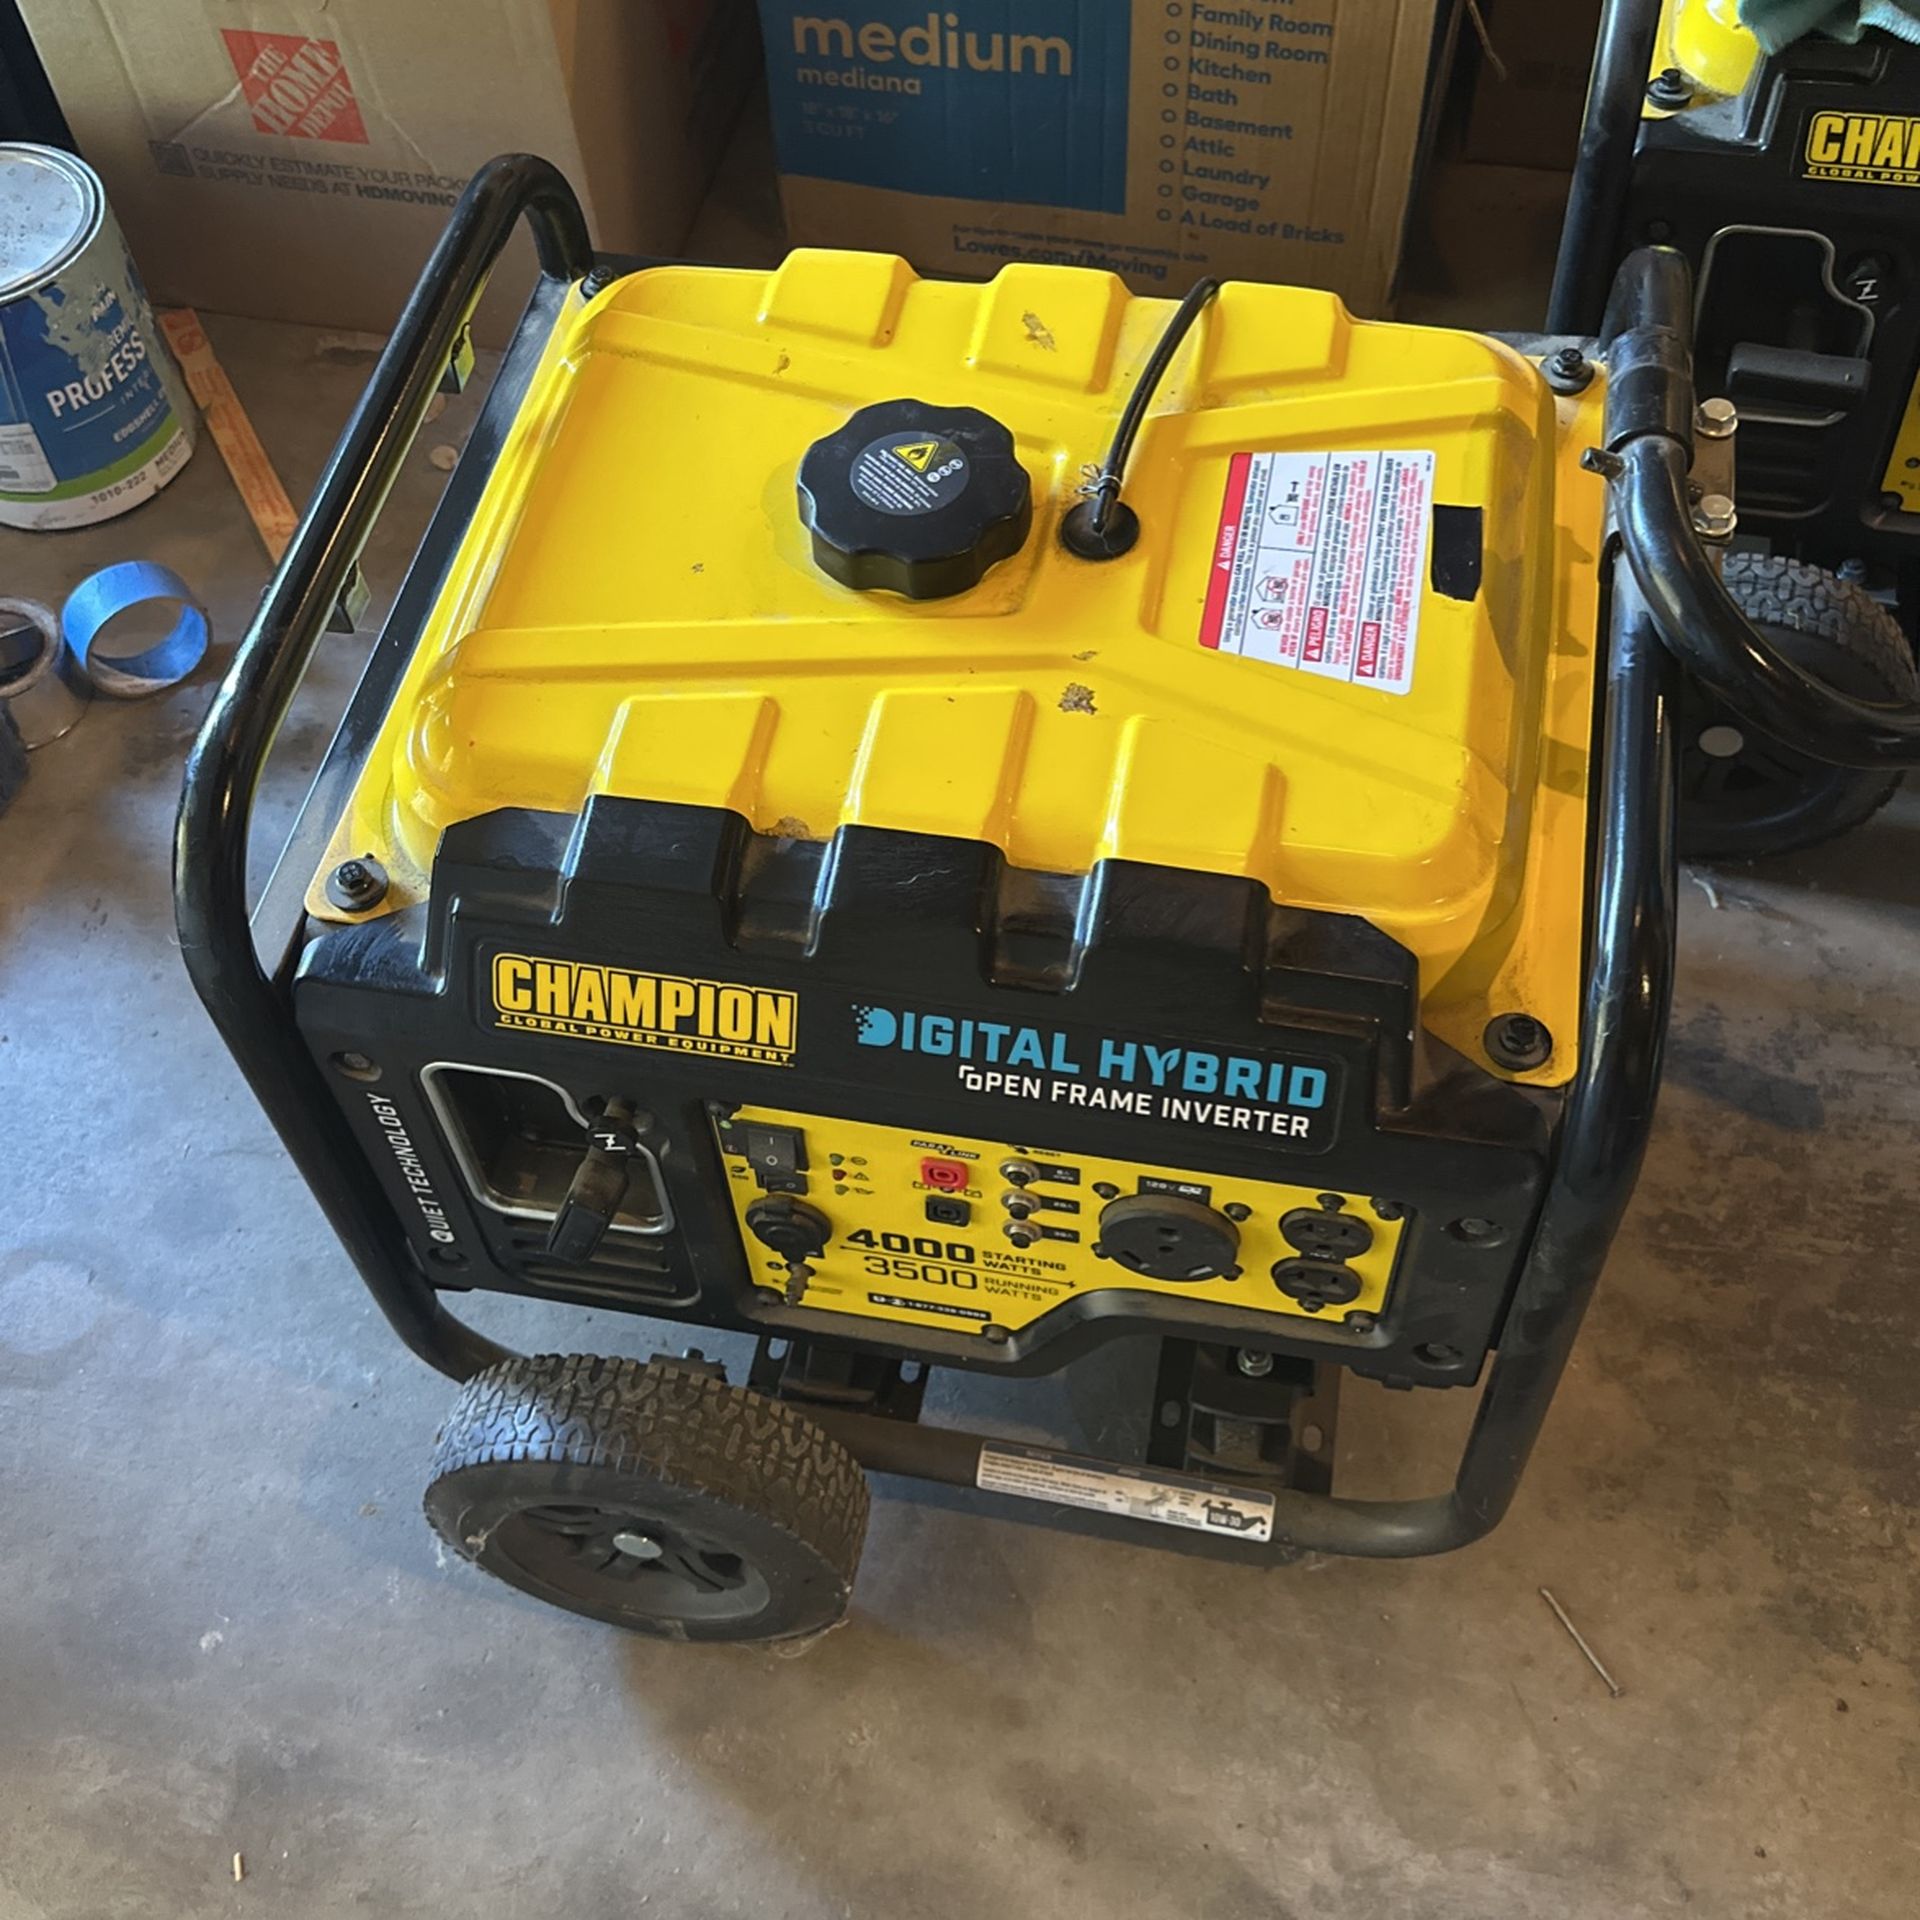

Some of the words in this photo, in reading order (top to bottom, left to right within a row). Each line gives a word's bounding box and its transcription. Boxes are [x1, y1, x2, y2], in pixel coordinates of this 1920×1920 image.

[1191, 3, 1263, 31] Family
[1270, 14, 1333, 37] Room
[793, 13, 1072, 76] medium
[1190, 30, 1260, 59] Dining
[1265, 41, 1328, 64] Room
[251, 37, 339, 137] HOME
[796, 67, 922, 95] mediana
[1189, 57, 1272, 84] Kitchen
[1187, 83, 1238, 105] Bath
[1185, 109, 1293, 139] Basement
[1185, 136, 1235, 157] Attic
[193, 147, 265, 170] QUICKLY
[270, 156, 352, 180] ESTIMATE
[354, 166, 412, 187] YOUR
[1183, 160, 1270, 190] Laundry
[1808, 166, 1875, 179] GLOBAL
[269, 174, 328, 194] NEEDS
[332, 182, 352, 196] AT
[1181, 185, 1260, 212] Garage
[1180, 209, 1195, 225] A
[1201, 212, 1251, 234] Load
[1256, 221, 1278, 237] of
[1282, 224, 1345, 244] Bricks
[953, 235, 1168, 279] Lowes.com/Moving
[1219, 524, 1235, 558] DANGER
[1307, 609, 1325, 648] PELIGRO
[1361, 624, 1378, 663] DANGER
[495, 956, 796, 1050] CHAMPION
[500, 1014, 578, 1033] GLOBAL
[586, 1026, 658, 1046] POWER
[668, 1038, 791, 1063] EQUIPMENT
[852, 1004, 1079, 1074] DIGITAL
[1100, 1038, 1326, 1108] HYBRID
[959, 1066, 1041, 1099] OPEN
[1051, 1080, 1151, 1116] FRAME
[1161, 1095, 1309, 1138] INVERTER
[366, 1093, 433, 1195] TECHNOLOGY
[416, 1197, 455, 1244] QUIET
[847, 1229, 975, 1264] 4000
[982, 1250, 1067, 1271] STARTING
[864, 1256, 978, 1290] 3500
[983, 1259, 1042, 1276] WATTS
[984, 1277, 1059, 1296] RUNNING
[985, 1287, 1042, 1301] WATTS
